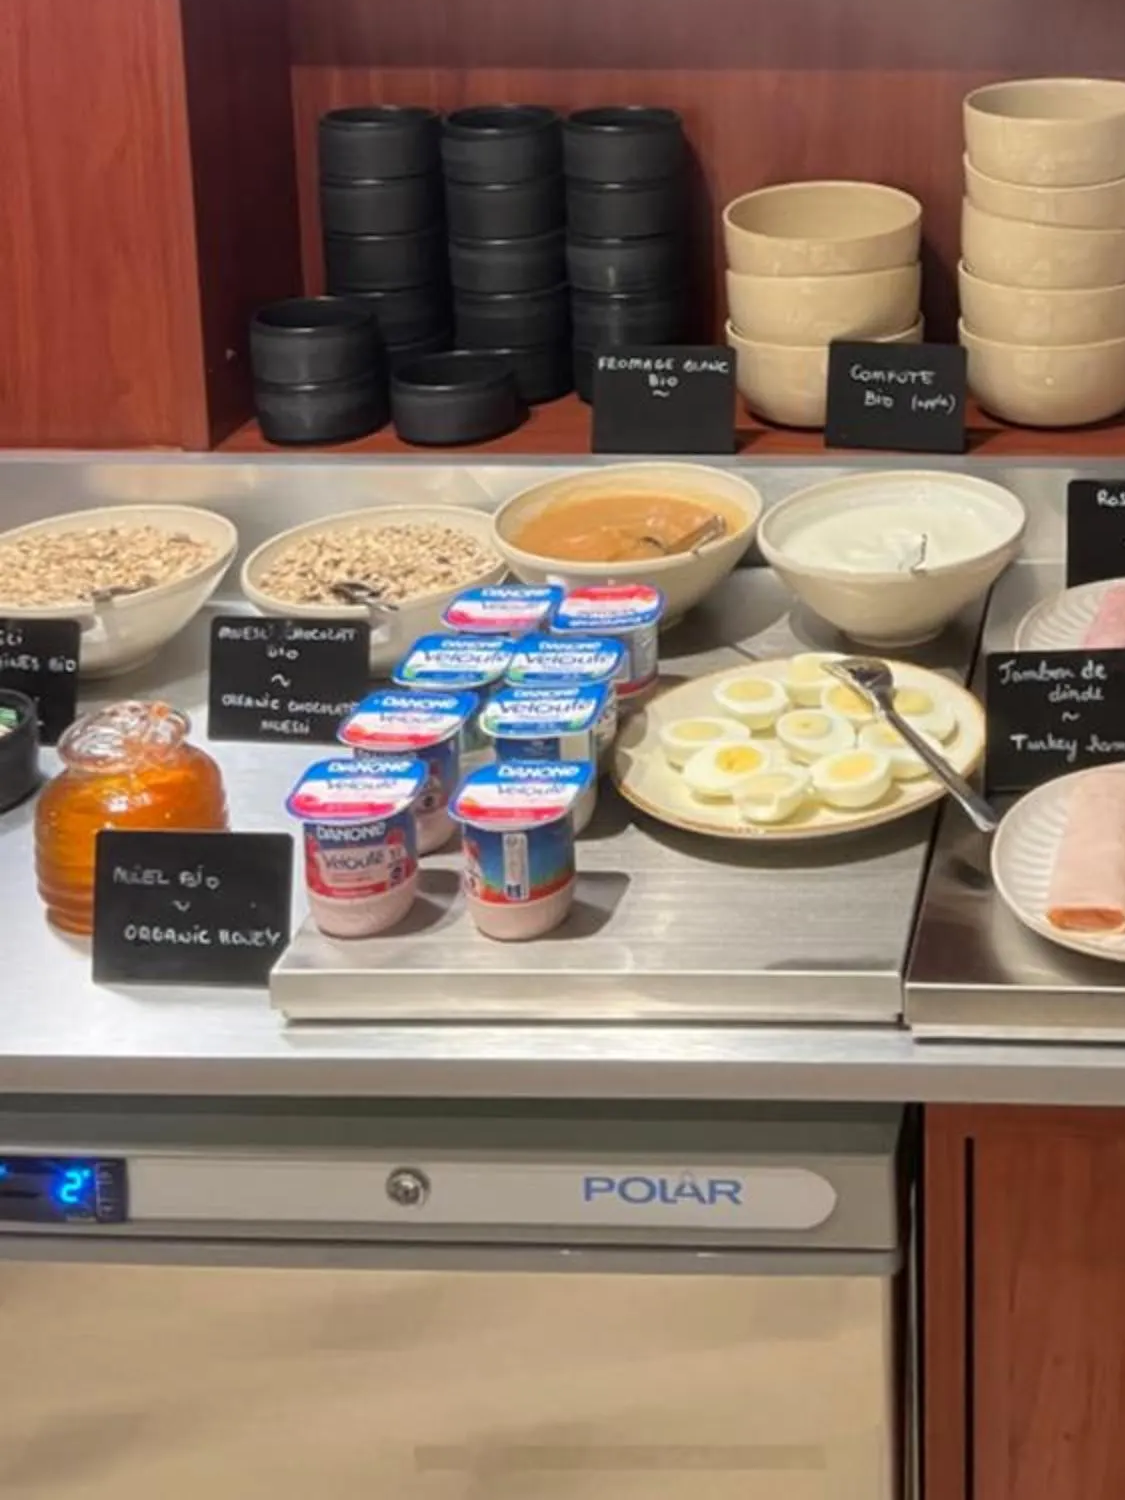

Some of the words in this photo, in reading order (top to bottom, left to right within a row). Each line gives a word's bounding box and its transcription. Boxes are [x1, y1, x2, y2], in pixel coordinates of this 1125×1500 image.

[598, 356, 674, 371] FROMAGE
[1080, 659, 1107, 680] de
[316, 821, 387, 842] DANONE
[583, 1172, 743, 1206] POLAR
